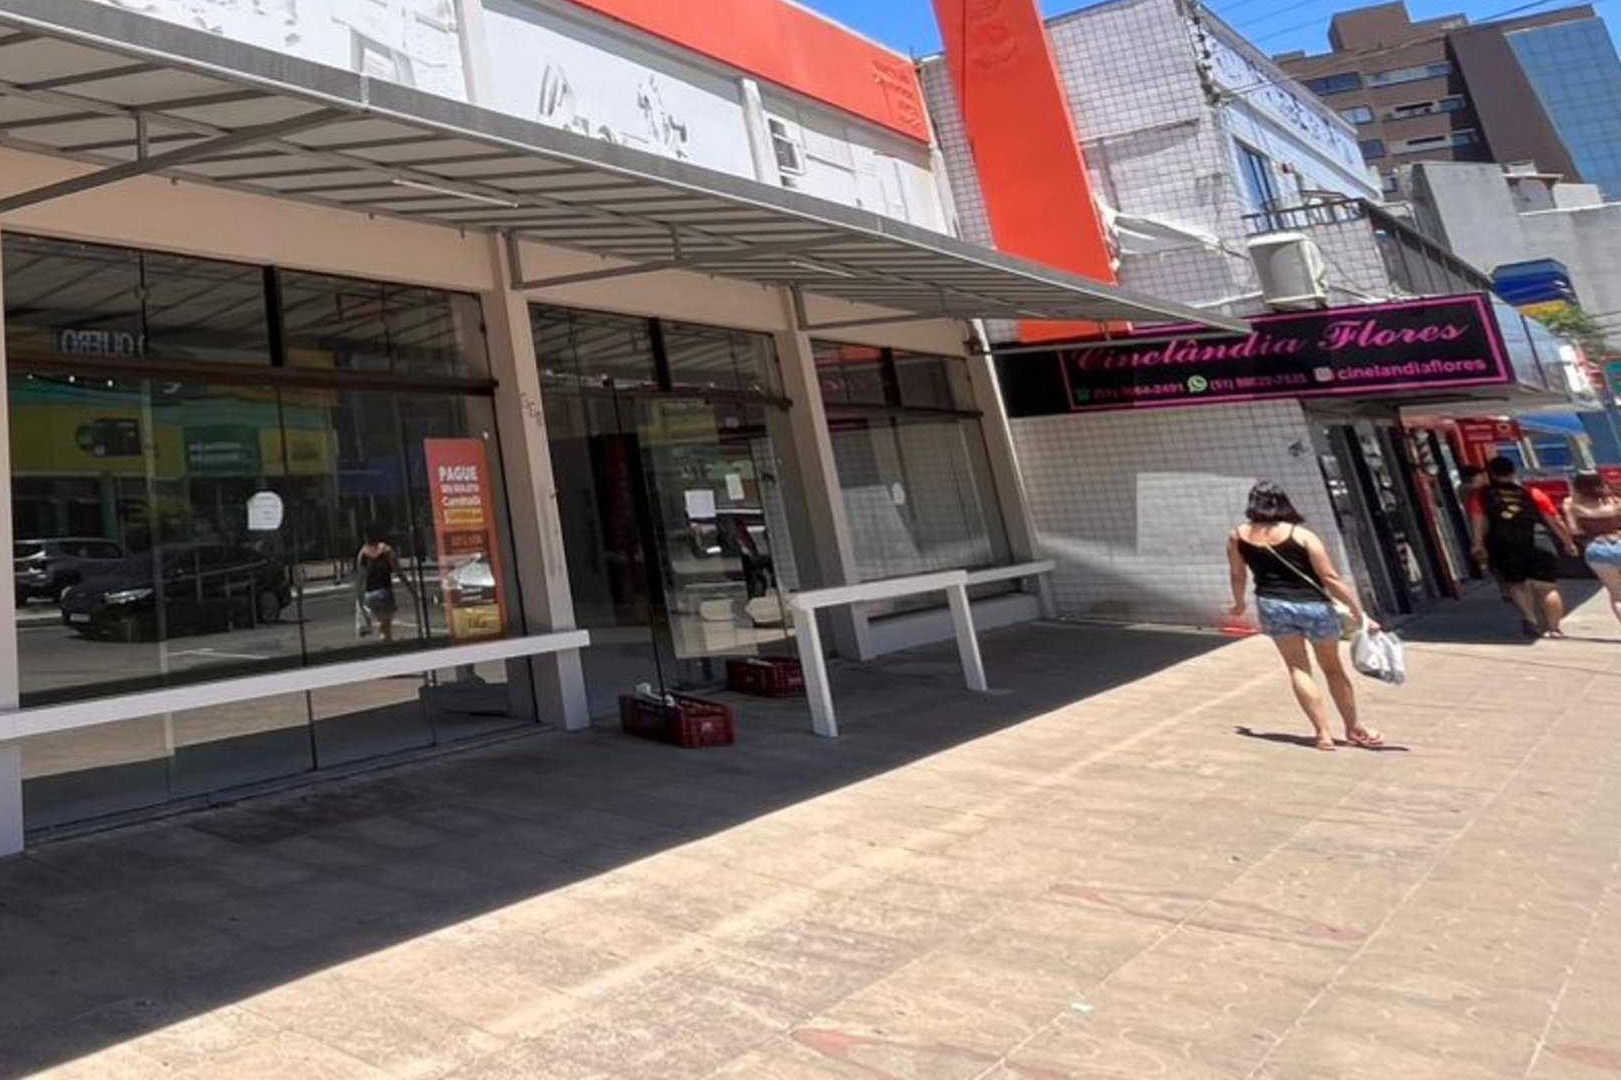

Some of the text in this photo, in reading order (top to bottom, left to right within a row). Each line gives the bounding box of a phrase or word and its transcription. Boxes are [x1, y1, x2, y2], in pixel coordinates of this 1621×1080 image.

[1071, 318, 1469, 370] Cinelândia Flores
[1337, 358, 1487, 381] cinelandiaflores
[438, 465, 478, 481] PAGUE
